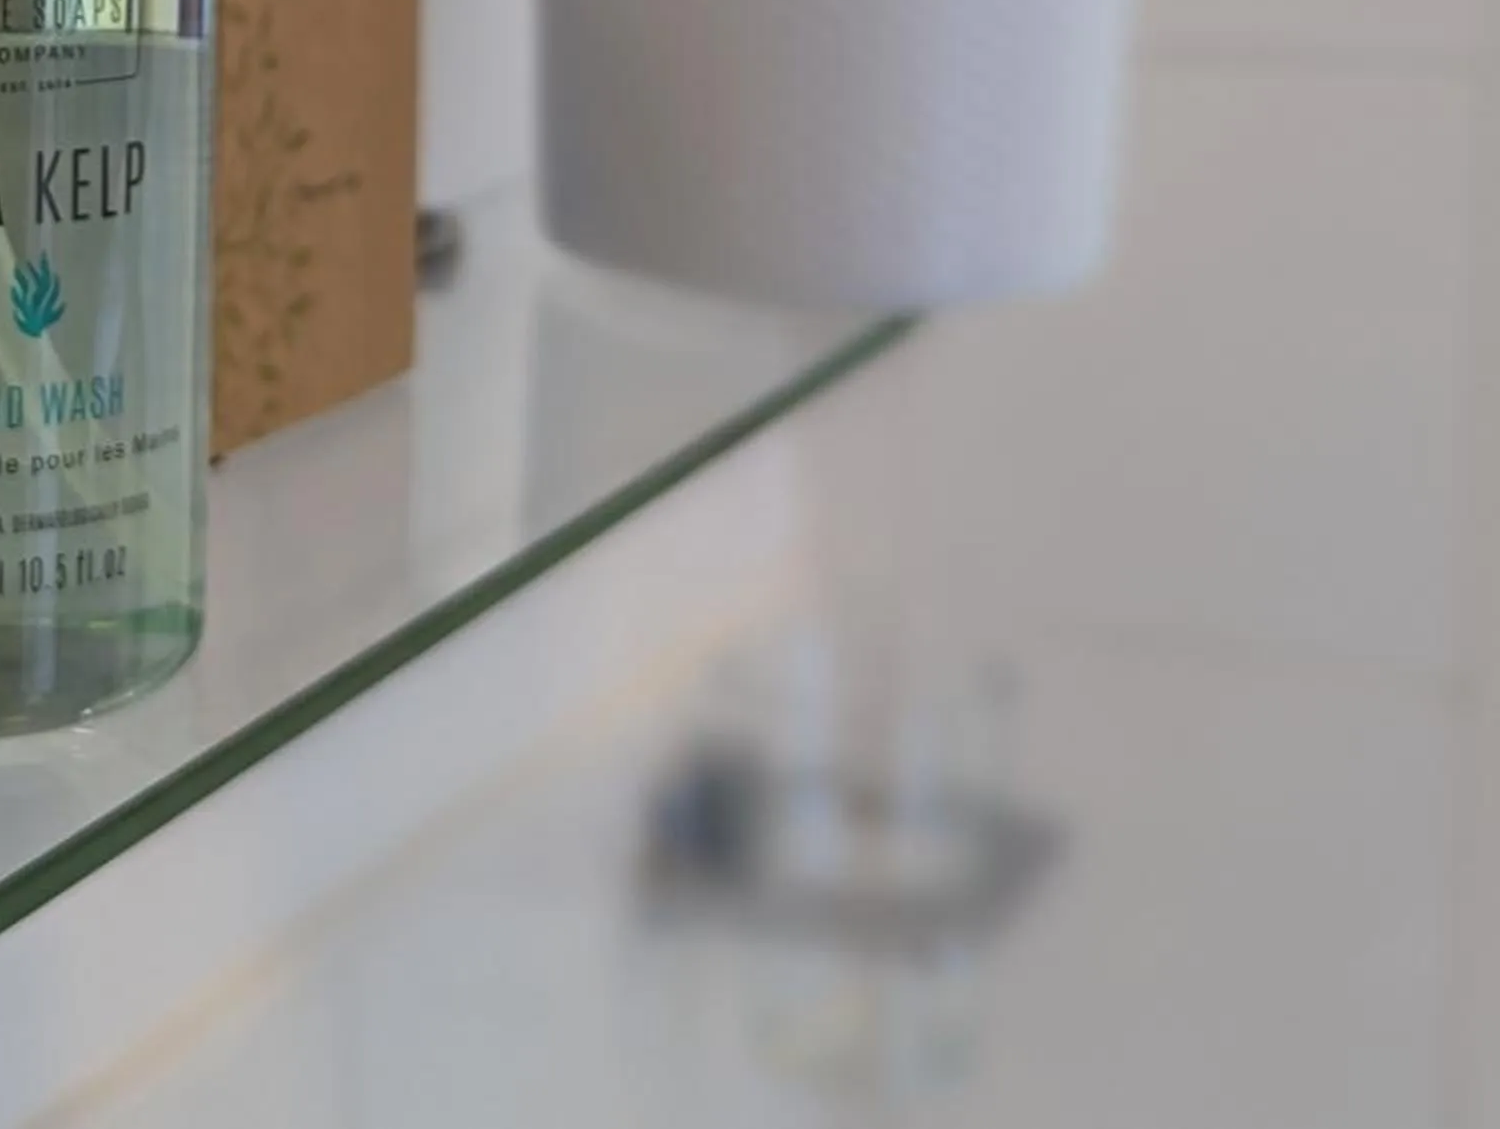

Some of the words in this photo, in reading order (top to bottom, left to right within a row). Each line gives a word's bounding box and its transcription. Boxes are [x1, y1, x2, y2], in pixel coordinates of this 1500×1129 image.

[35, 140, 146, 225] KELP
[40, 374, 125, 426] WASH
[30, 449, 89, 478] pour
[18, 552, 67, 594] 10.5
